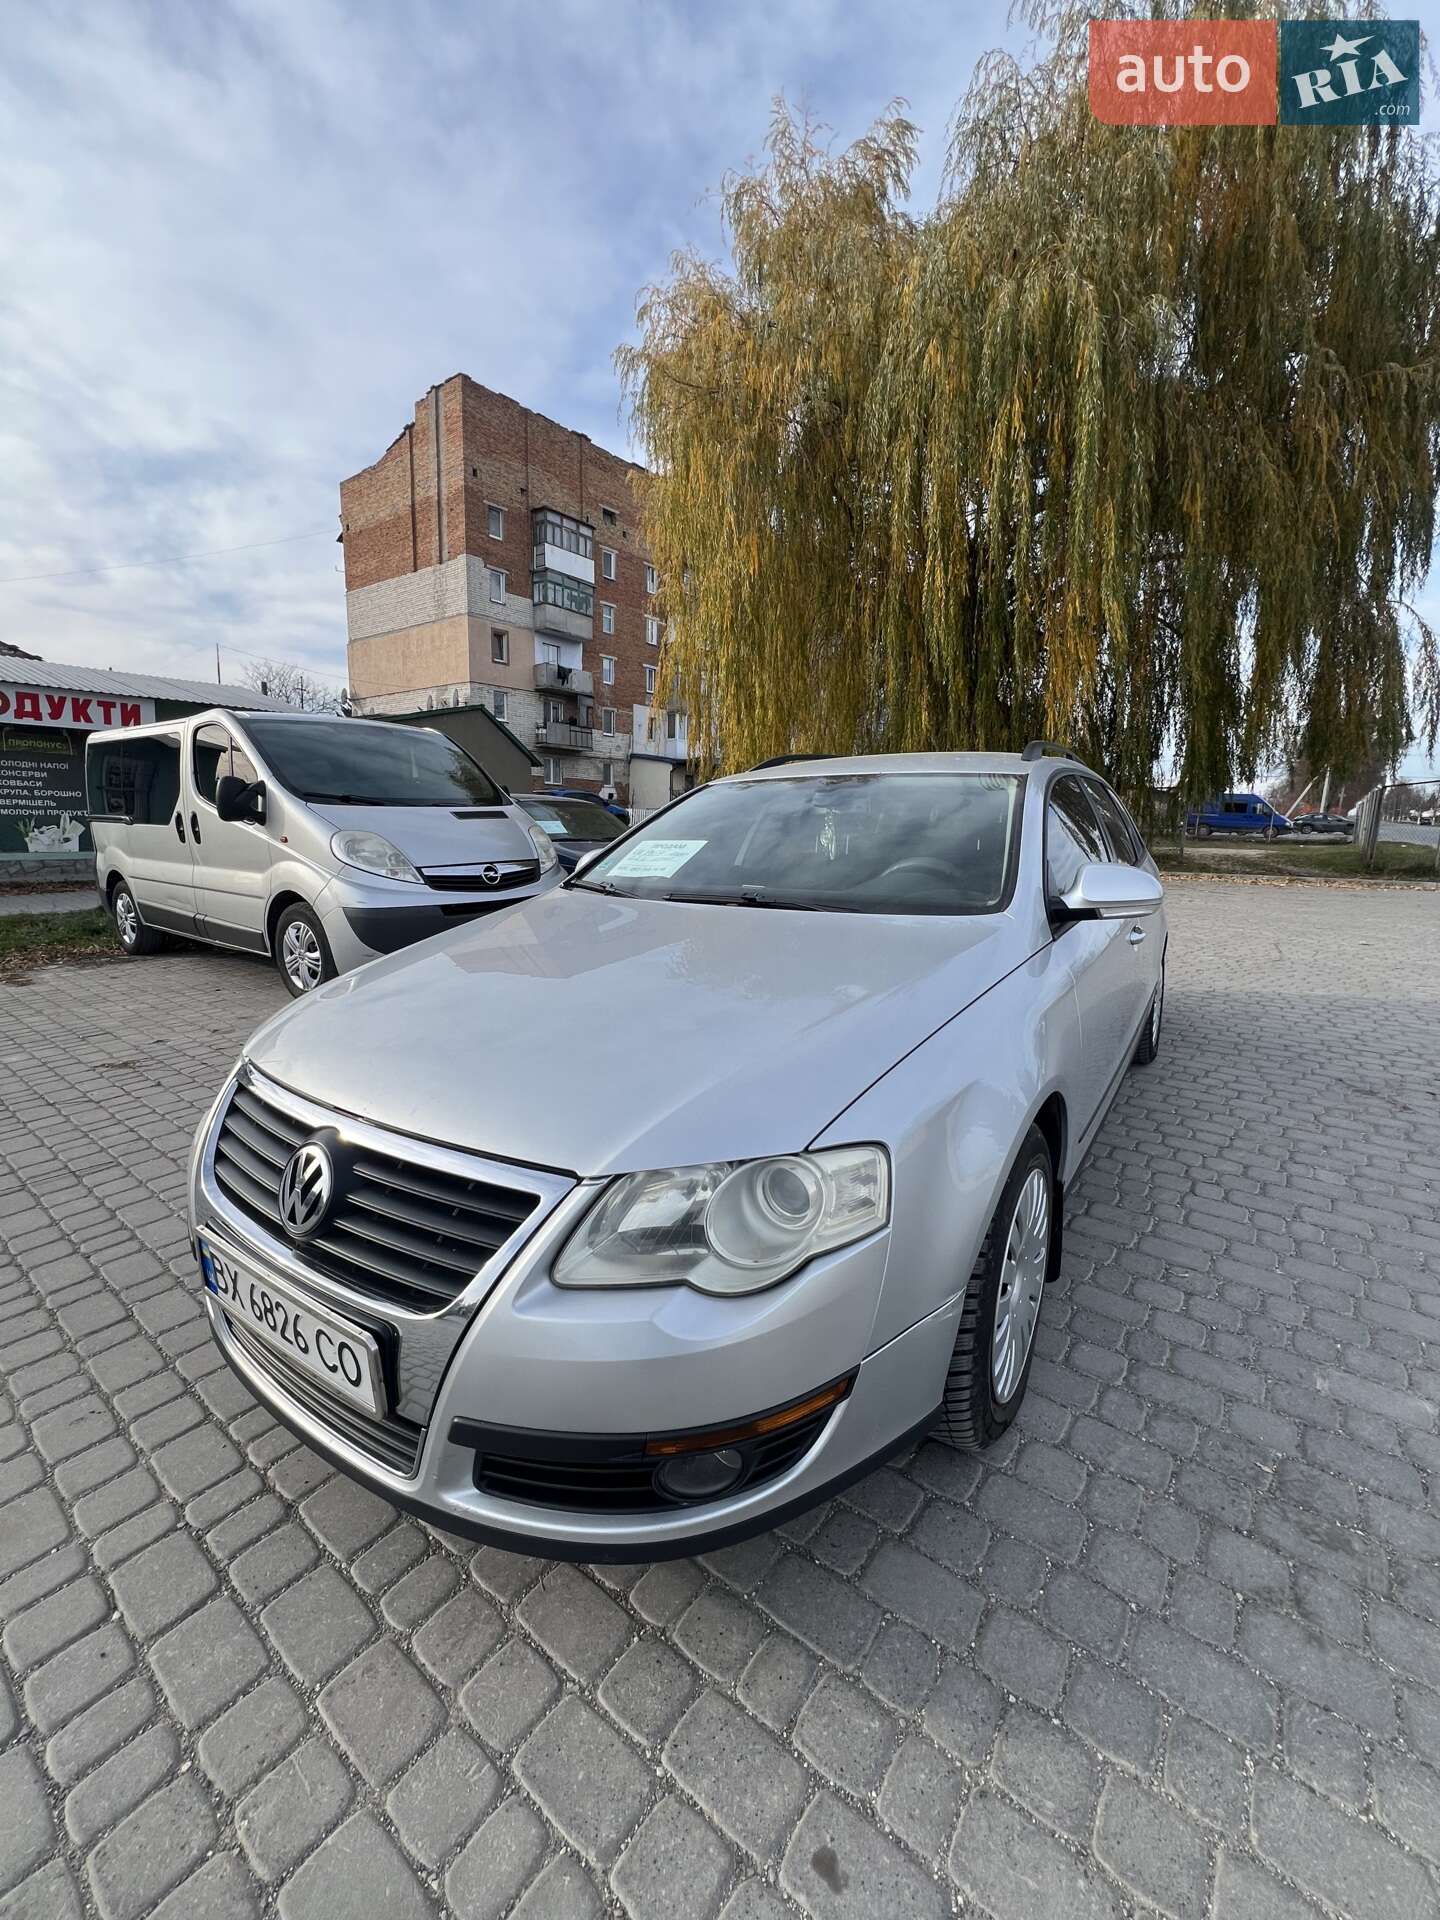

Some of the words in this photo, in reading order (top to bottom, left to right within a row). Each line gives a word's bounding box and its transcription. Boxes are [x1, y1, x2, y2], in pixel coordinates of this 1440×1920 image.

[0, 769, 48, 778] ОНСЕРВИ
[33, 789, 82, 798] БОРОШНО
[47, 809, 88, 818] ПРОДУКТ
[249, 1282, 310, 1355] 6826
[315, 1328, 362, 1388] CO
